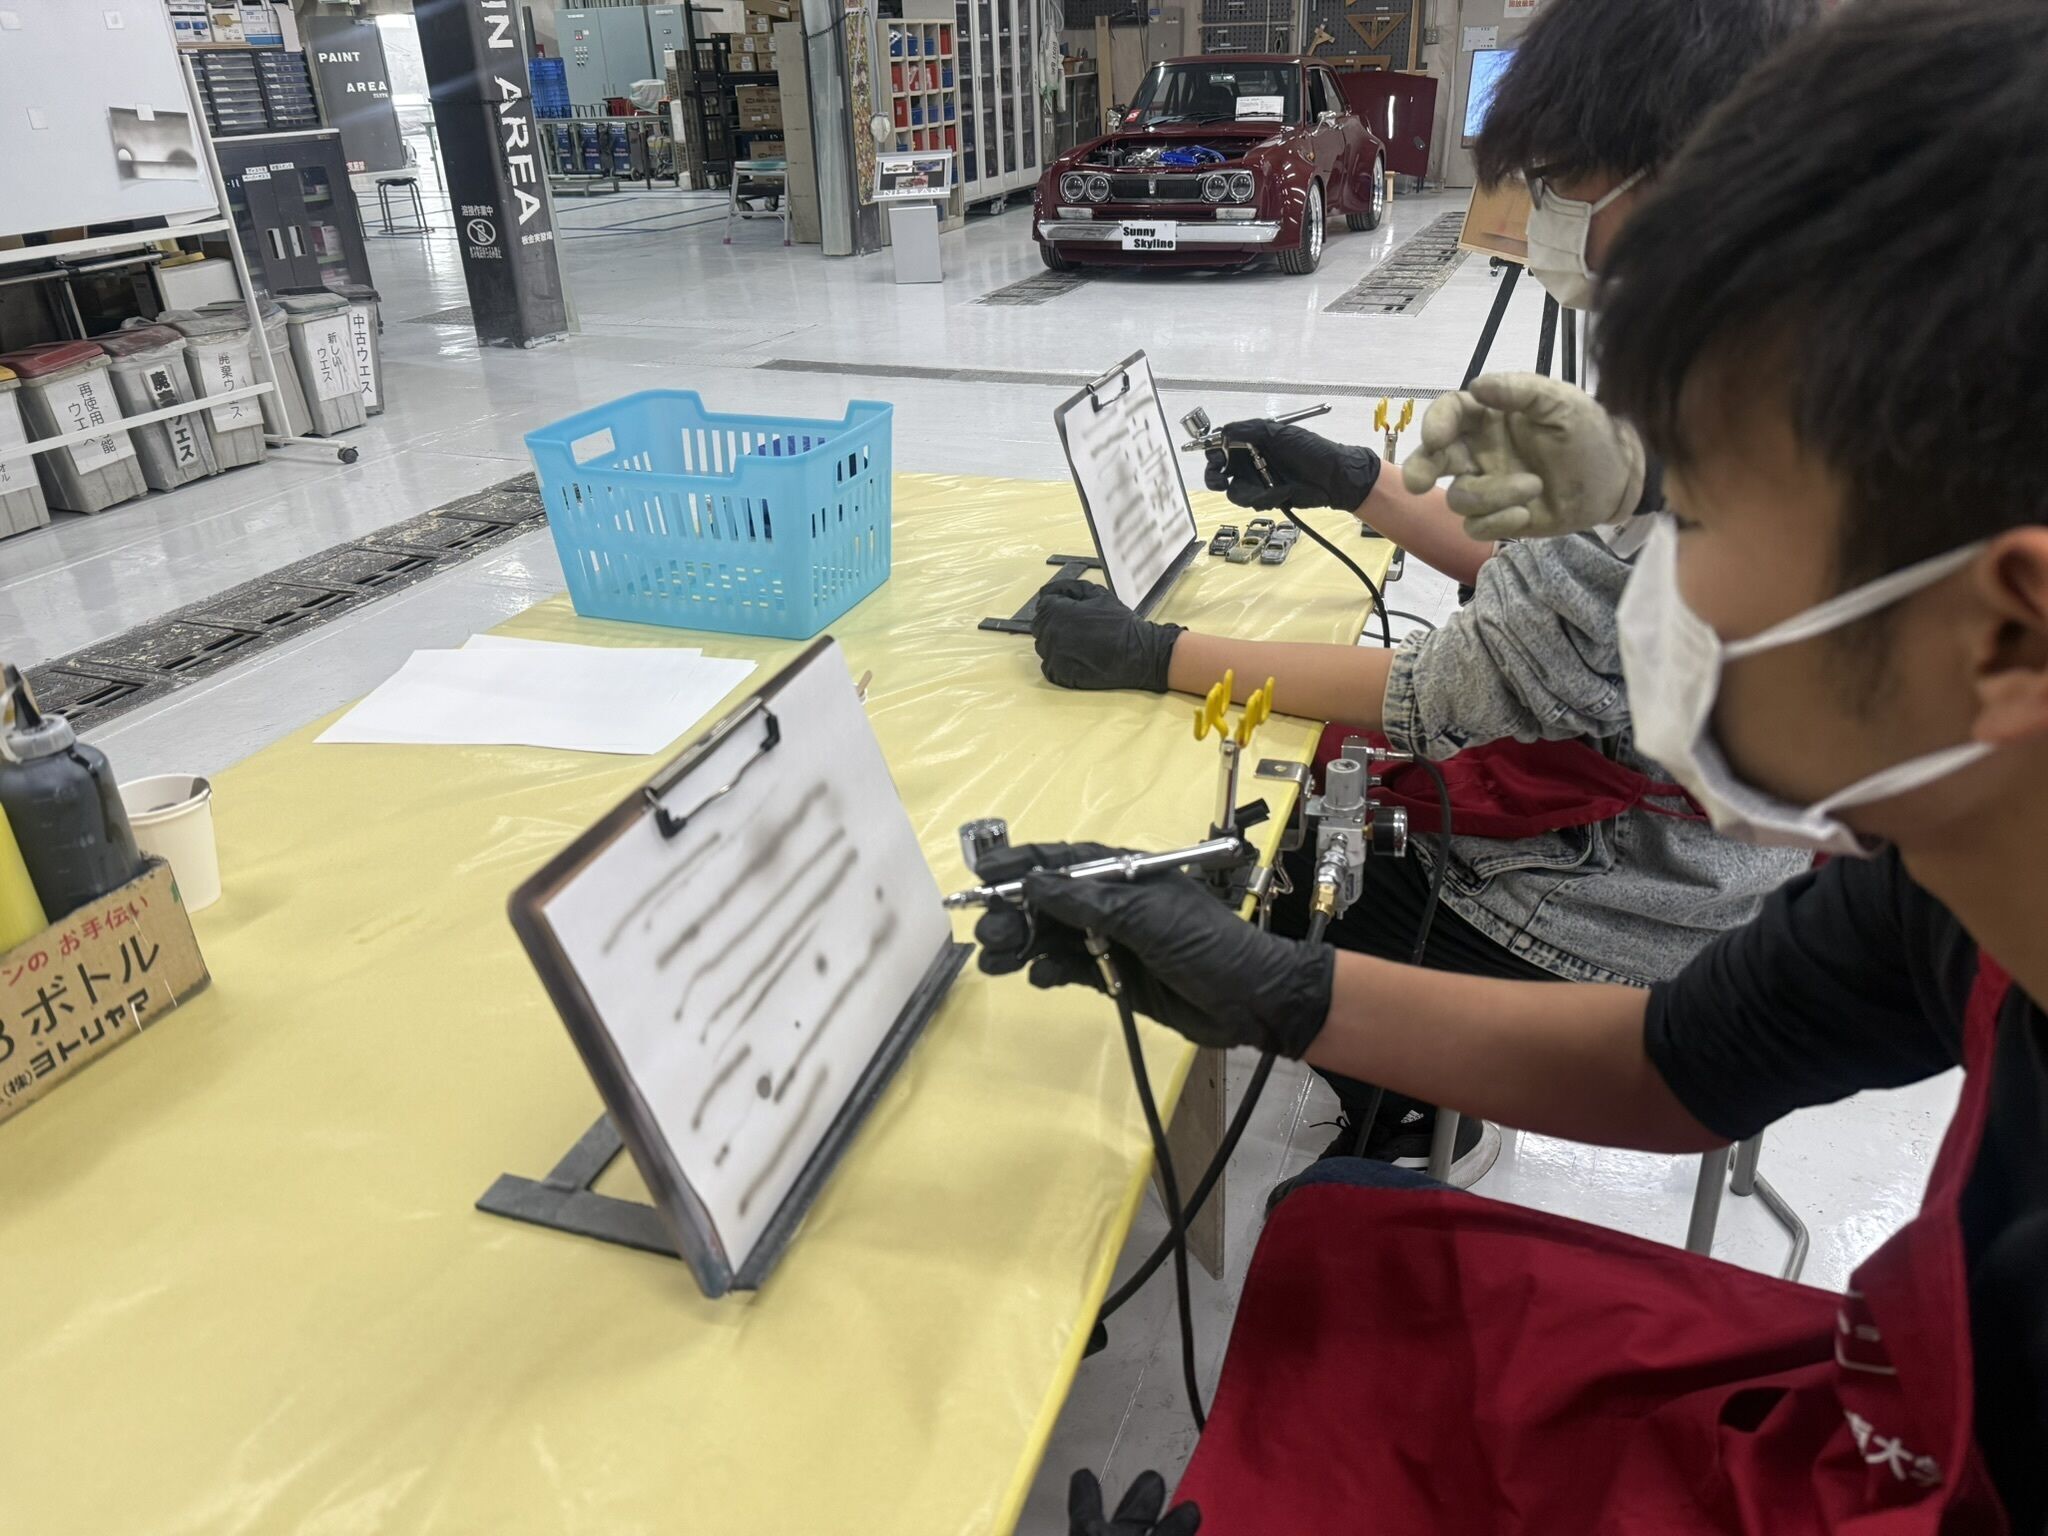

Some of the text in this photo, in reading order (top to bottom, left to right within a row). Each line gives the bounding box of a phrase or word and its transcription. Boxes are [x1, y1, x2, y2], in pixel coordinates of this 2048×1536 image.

[318, 52, 360, 63] PAINT
[346, 81, 388, 93] AREA
[494, 75, 541, 226] AREA
[883, 187, 940, 196] NISSAN
[1123, 226, 1156, 237] Sunny
[1134, 238, 1174, 249] Skyline
[327, 331, 343, 367] 新しい
[353, 313, 373, 394] 中古ウエス
[317, 348, 333, 383] ウエス
[77, 381, 117, 455] 再使用能
